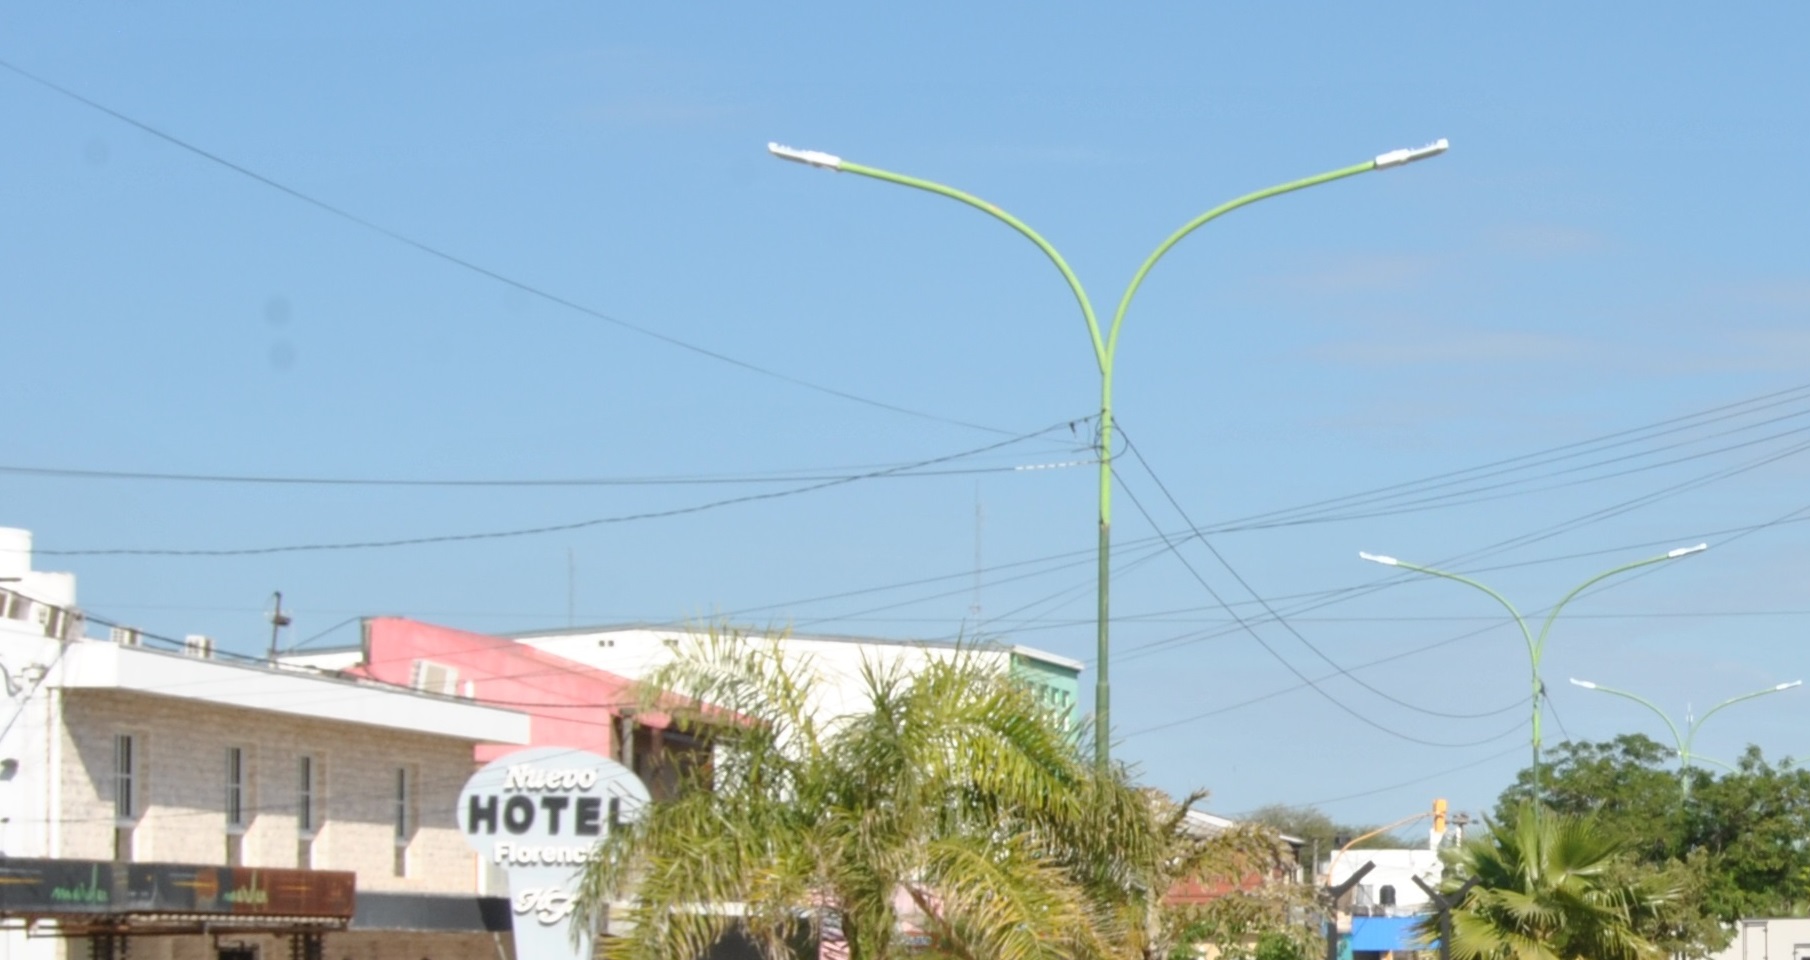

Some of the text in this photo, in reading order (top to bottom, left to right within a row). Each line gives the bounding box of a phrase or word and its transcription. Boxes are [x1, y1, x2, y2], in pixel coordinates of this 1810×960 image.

[503, 763, 599, 791] Nuevo
[468, 794, 636, 836] HOTEL
[494, 841, 612, 865] Florenci
